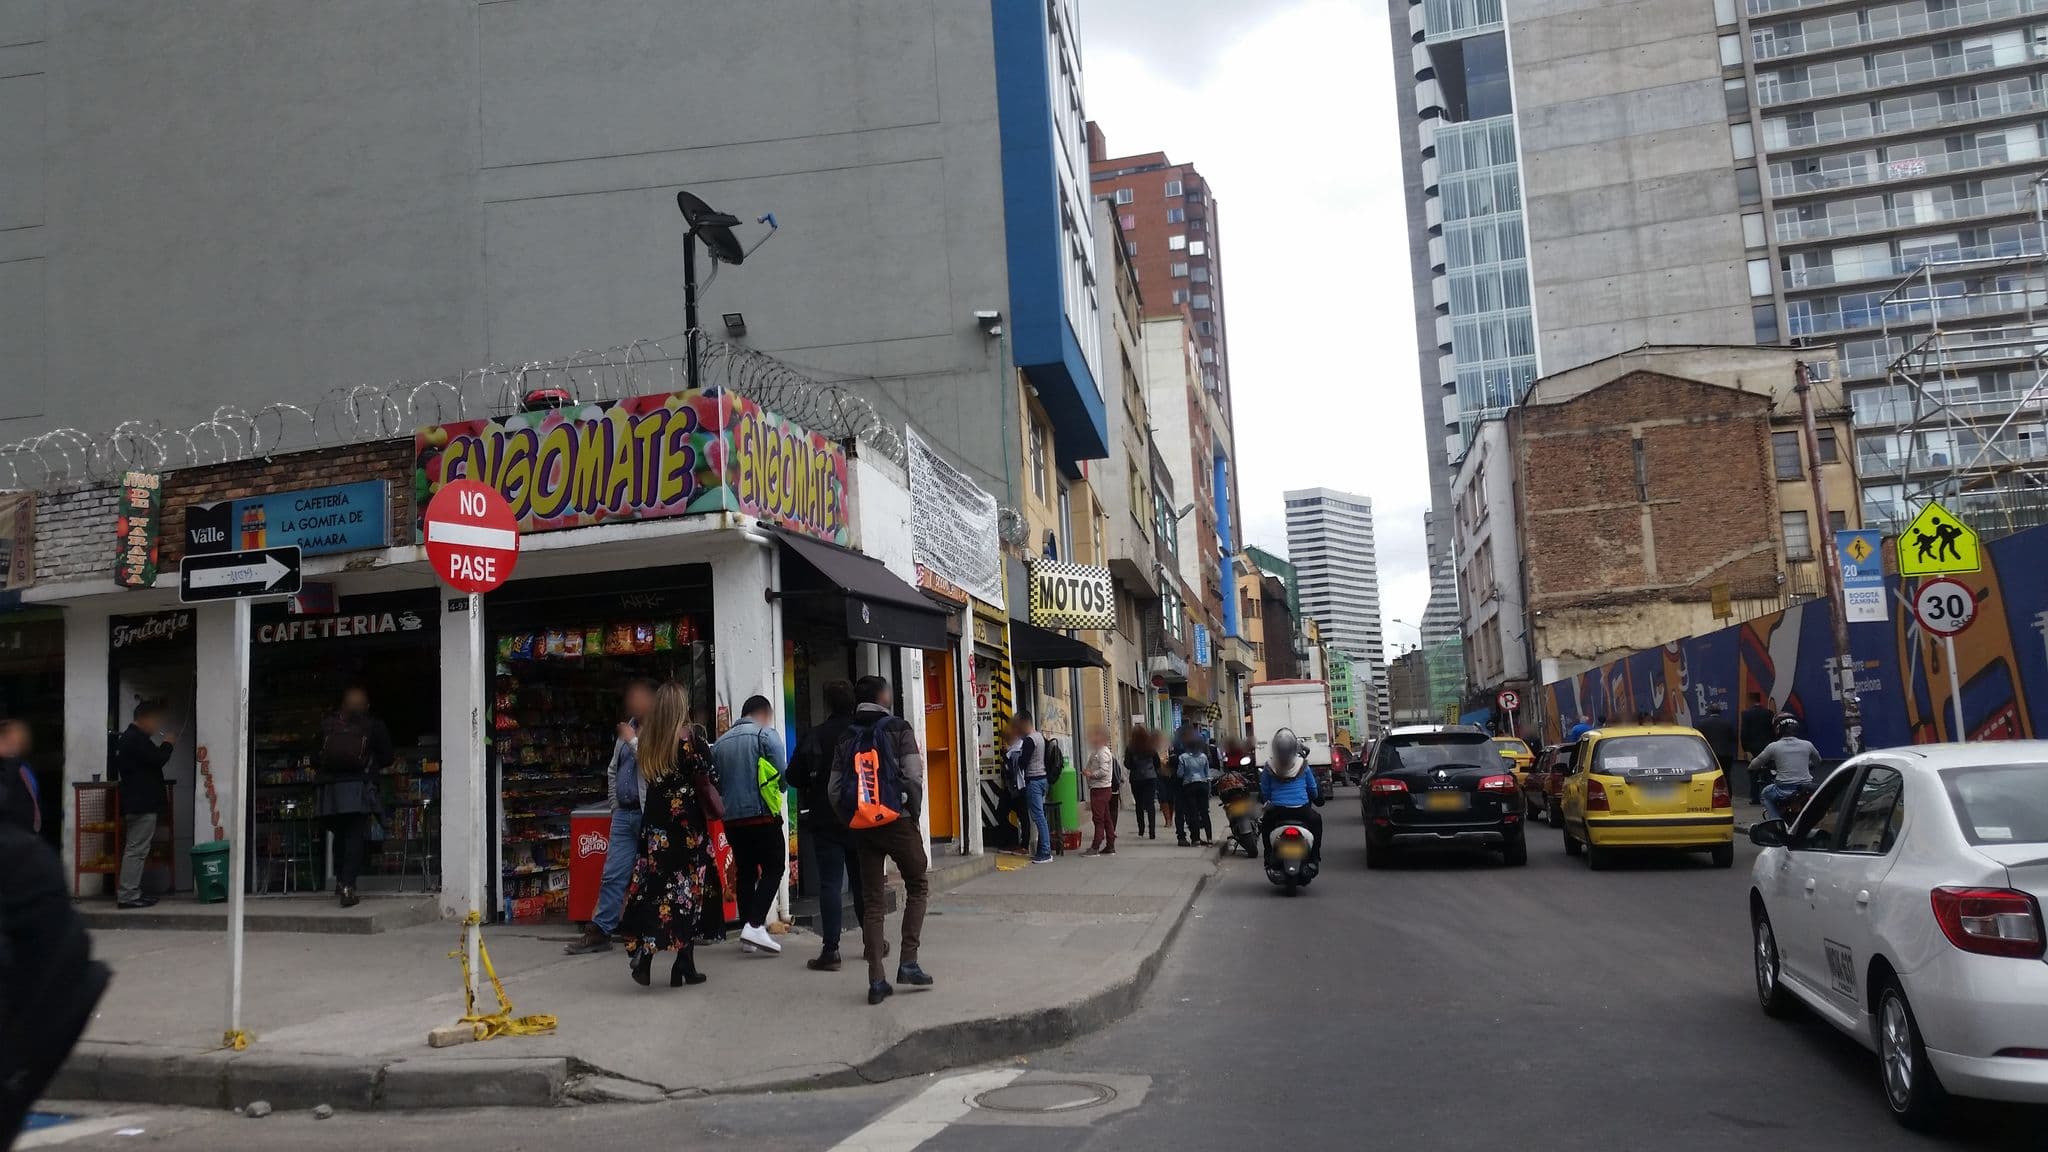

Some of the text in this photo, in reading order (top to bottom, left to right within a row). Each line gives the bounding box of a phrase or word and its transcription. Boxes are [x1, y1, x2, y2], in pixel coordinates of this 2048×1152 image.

[441, 407, 698, 520] ENGOMATE
[739, 413, 837, 532] ENGOMATE
[124, 471, 160, 489] JUGOS
[294, 491, 350, 512] CAFETERÍA
[460, 490, 487, 517] NO
[281, 510, 364, 532] LA GOMITA DE
[190, 526, 225, 544] Valle
[297, 533, 347, 549] SAMARA
[126, 517, 150, 584] NARANJA
[450, 553, 497, 582] PASE
[1843, 564, 1857, 577] 20
[1039, 575, 1105, 613] MOTOS
[1927, 595, 1964, 620] 30
[258, 613, 397, 644] CAFETERIA
[1854, 676, 1882, 692] arcelona
